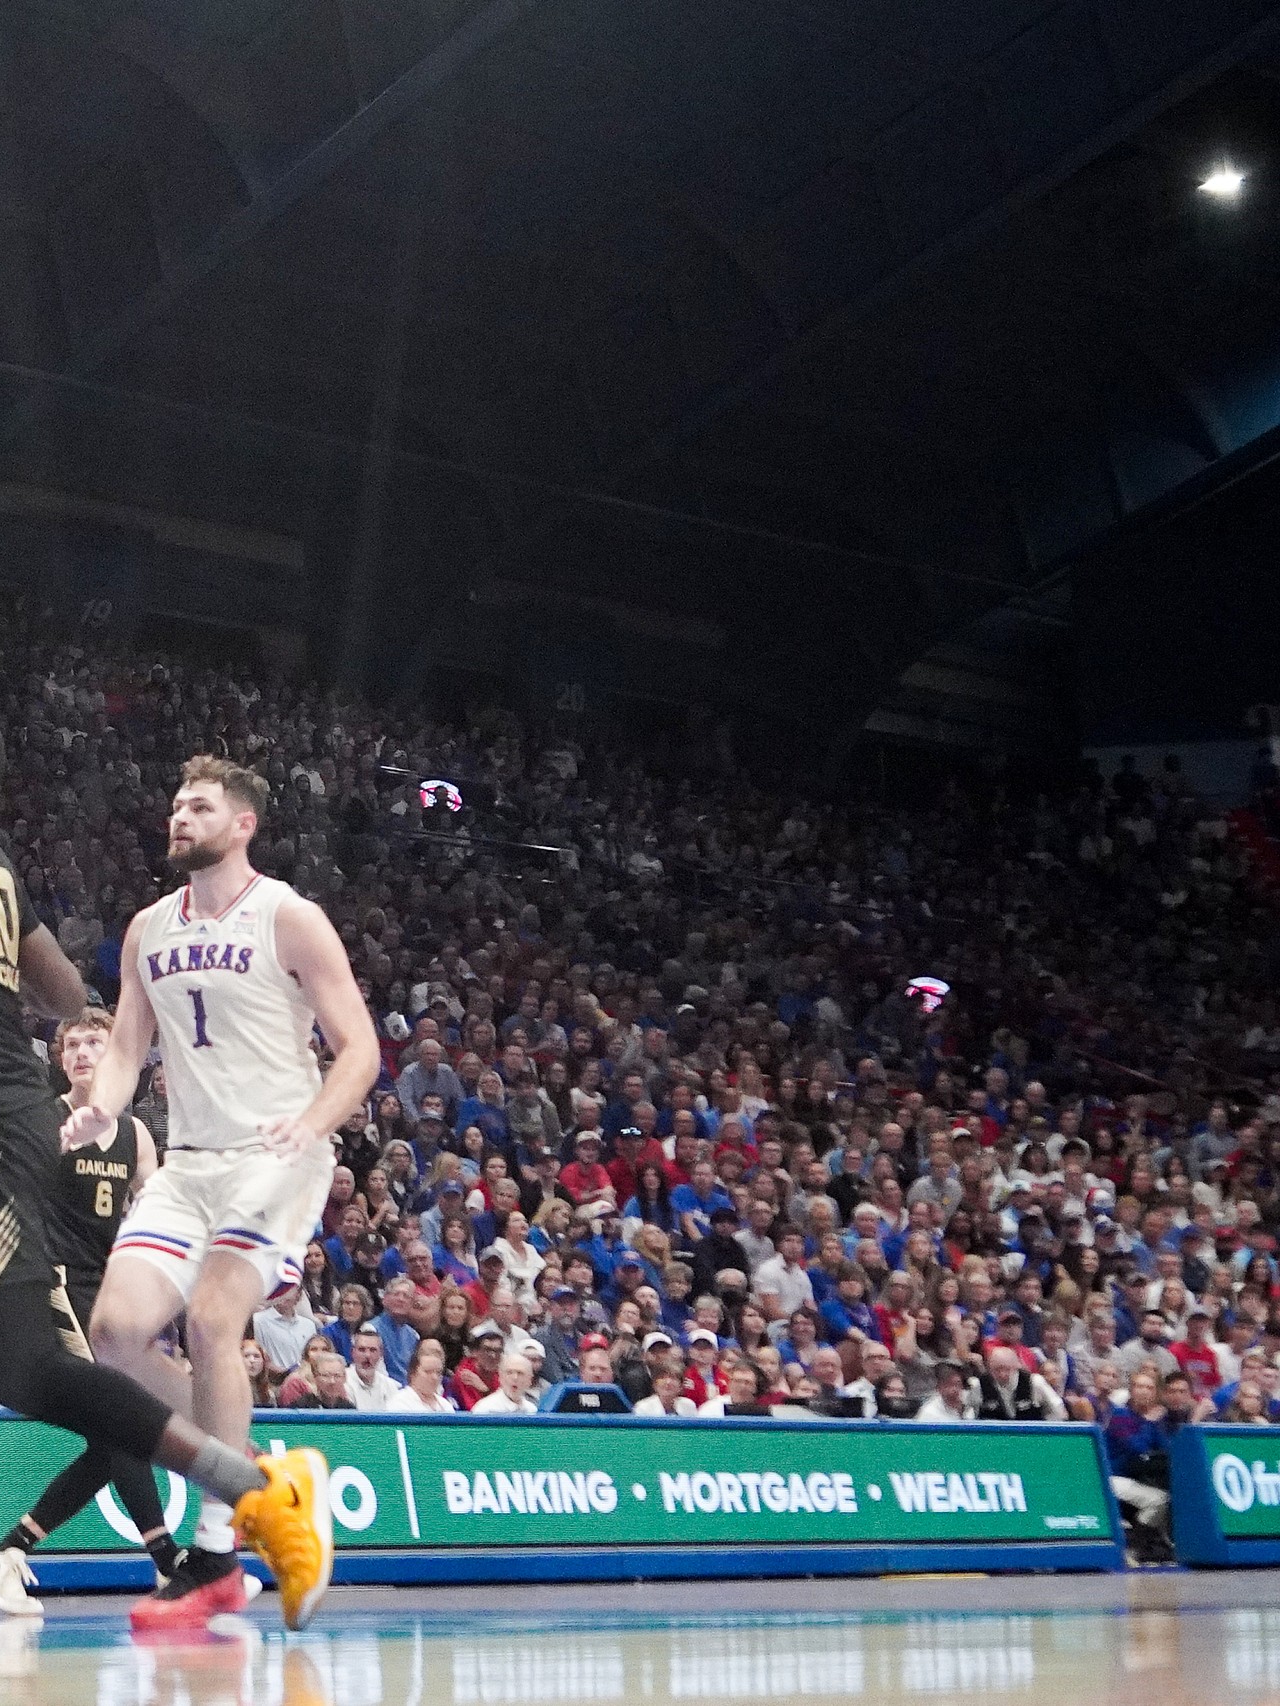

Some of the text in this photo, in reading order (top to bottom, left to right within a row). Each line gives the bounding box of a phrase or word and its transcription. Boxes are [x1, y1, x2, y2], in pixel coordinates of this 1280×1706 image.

[147, 943, 254, 982] KANSAS
[186, 988, 213, 1048] 1
[75, 1158, 128, 1179] OAKLAND
[95, 1180, 113, 1217] 6
[442, 1470, 1027, 1514] BANKING MORTGAGE WEALTH
